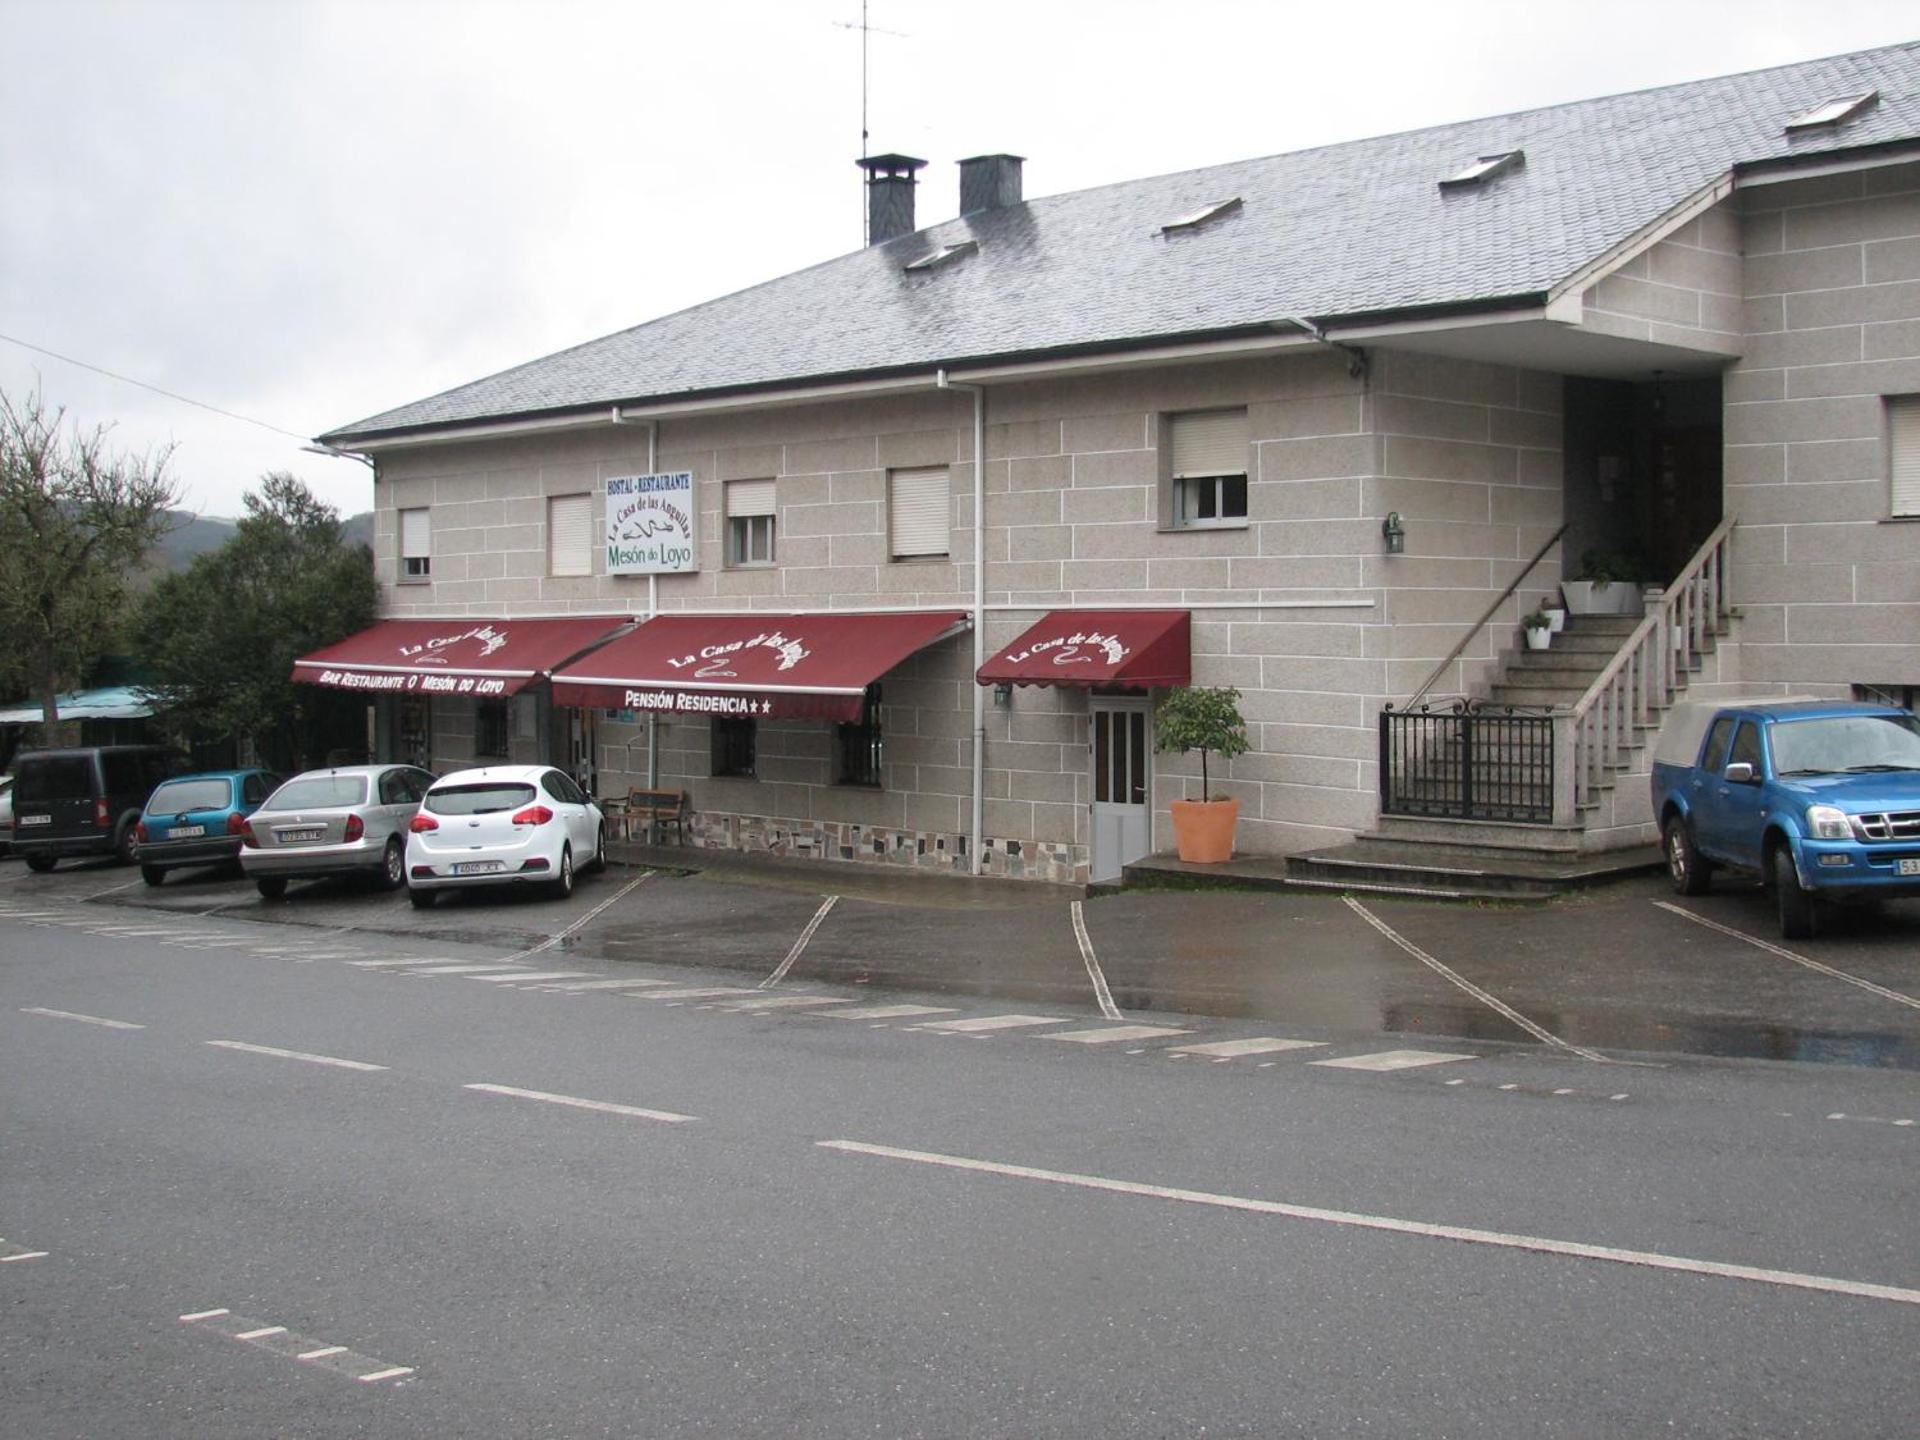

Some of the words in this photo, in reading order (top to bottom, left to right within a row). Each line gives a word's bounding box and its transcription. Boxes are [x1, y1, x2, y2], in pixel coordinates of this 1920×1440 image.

[607, 478, 633, 496] HOSTAL
[638, 473, 690, 493] RESTAURANTE
[617, 503, 636, 523] Casa
[637, 496, 646, 511] de
[647, 495, 659, 510] las
[608, 544, 646, 567] Mesón
[647, 548, 658, 561] do
[661, 543, 691, 569] Loyo
[399, 644, 422, 656] La
[667, 655, 697, 668] La
[701, 640, 744, 658] Casa
[1006, 651, 1030, 663] La
[1031, 636, 1065, 653] Casa
[1067, 632, 1086, 645] de
[319, 670, 341, 684] BAR
[341, 672, 405, 689] RESTAURANTE
[458, 679, 474, 692] DO
[476, 681, 505, 693] LOYO
[625, 690, 674, 709] PENSIÓN
[676, 692, 749, 714] RESIDENCIA
